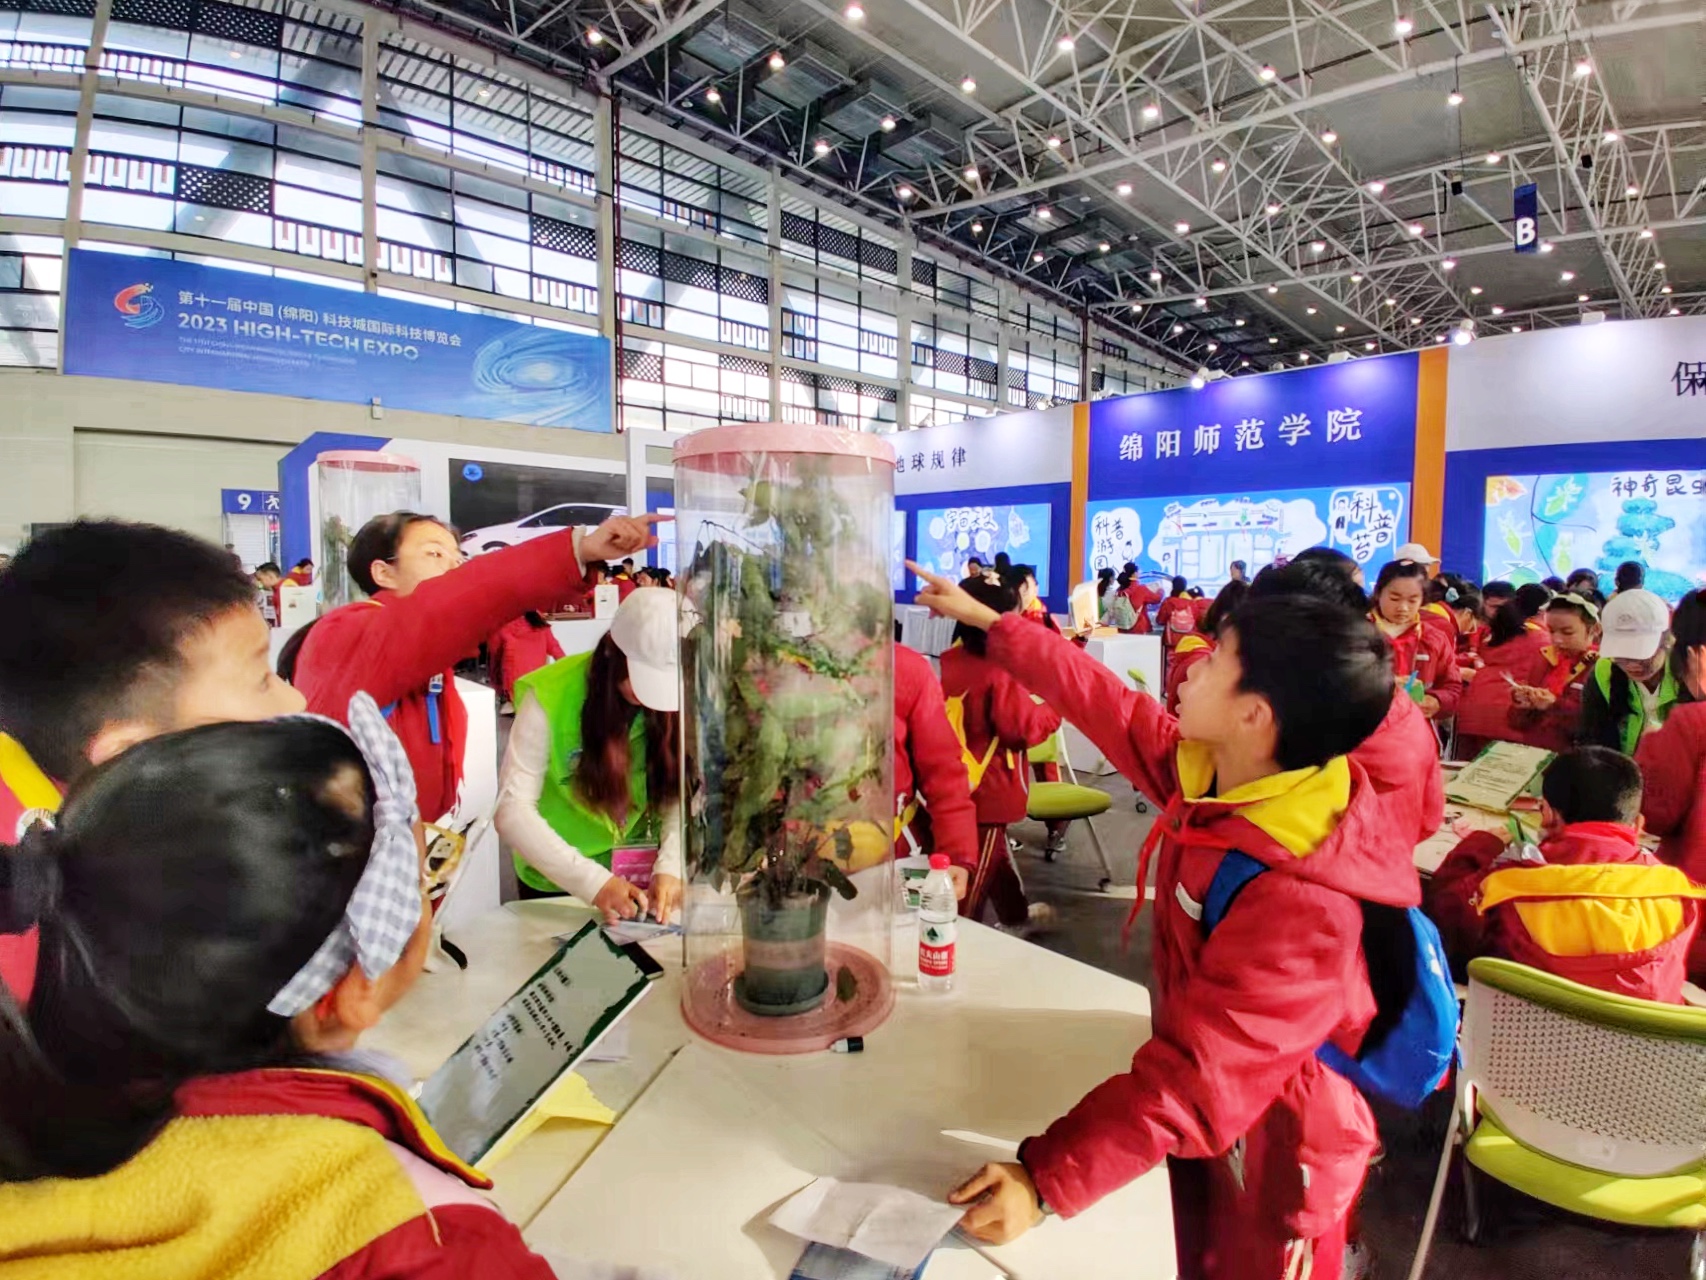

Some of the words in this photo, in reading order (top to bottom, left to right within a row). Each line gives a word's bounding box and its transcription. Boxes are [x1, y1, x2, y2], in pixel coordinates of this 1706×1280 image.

[1516, 217, 1536, 245] B
[178, 312, 227, 332] 2023
[233, 320, 359, 352] HIGH-TECH
[363, 339, 419, 360] EXPO
[1119, 407, 1363, 462] 绵阳师范学院
[237, 493, 252, 511] 9
